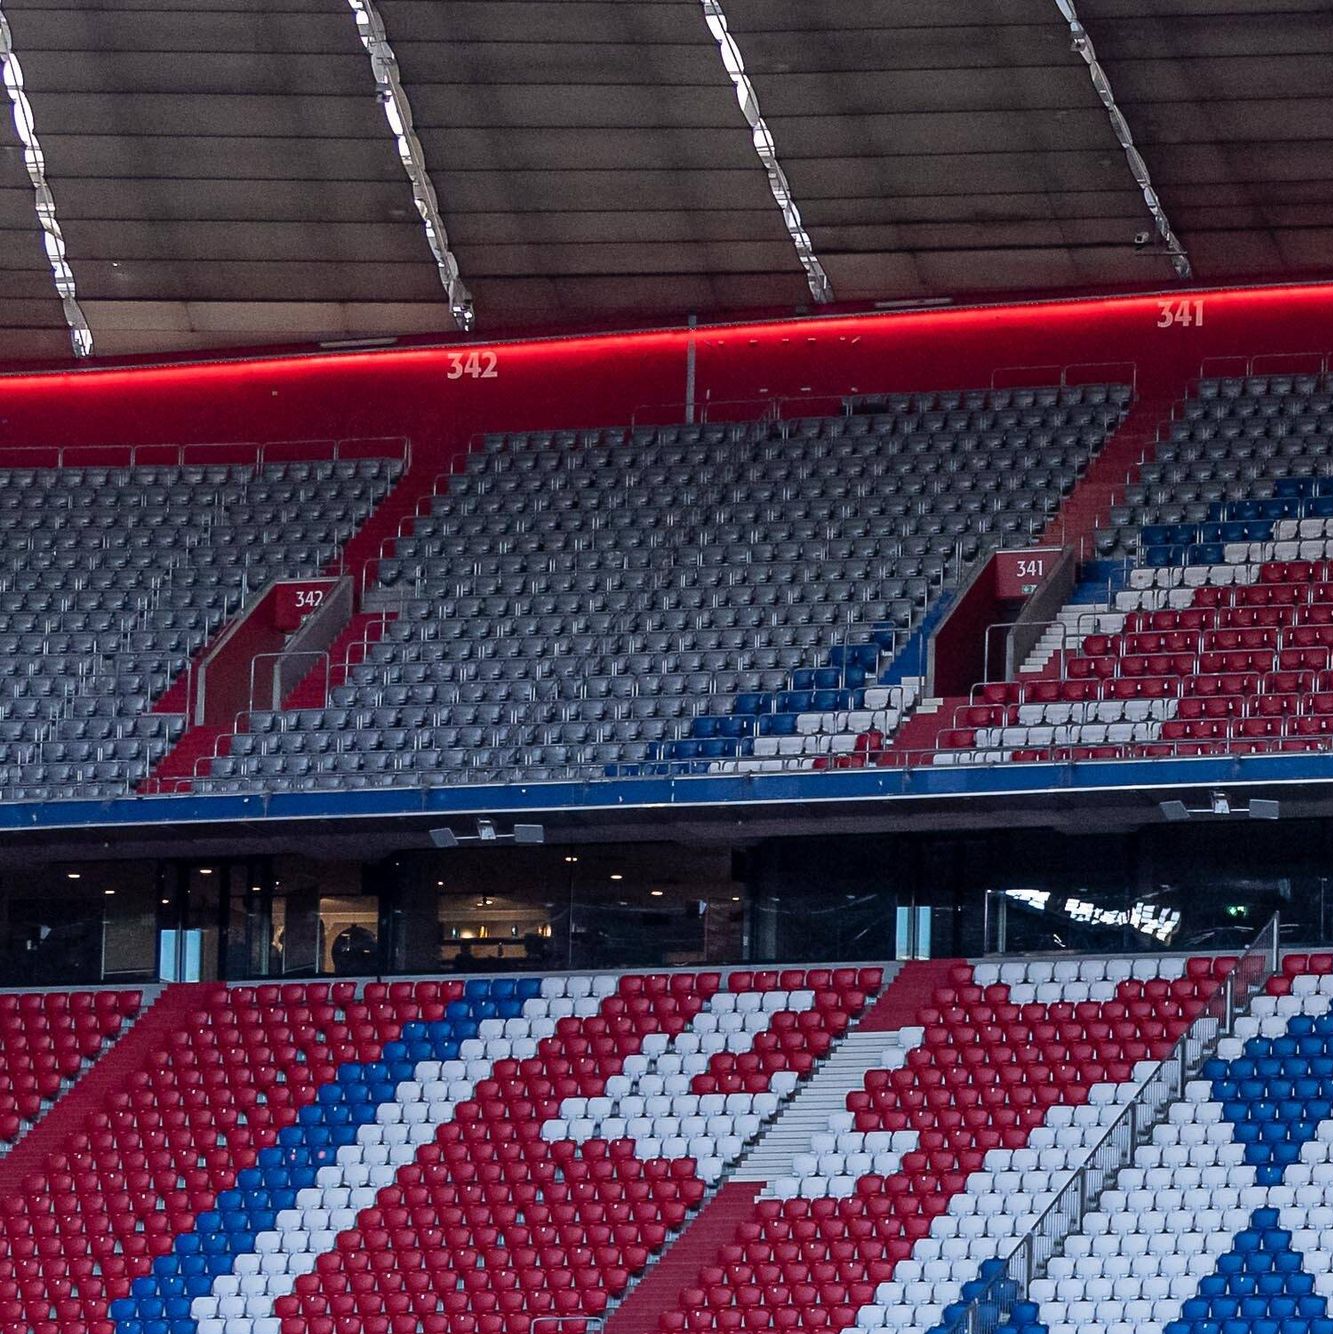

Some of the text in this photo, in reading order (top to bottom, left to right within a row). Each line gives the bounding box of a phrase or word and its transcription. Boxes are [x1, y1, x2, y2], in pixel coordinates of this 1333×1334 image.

[1157, 300, 1203, 327] 341
[447, 351, 498, 379] 342
[1016, 560, 1043, 576] 341
[295, 590, 323, 607] 342
